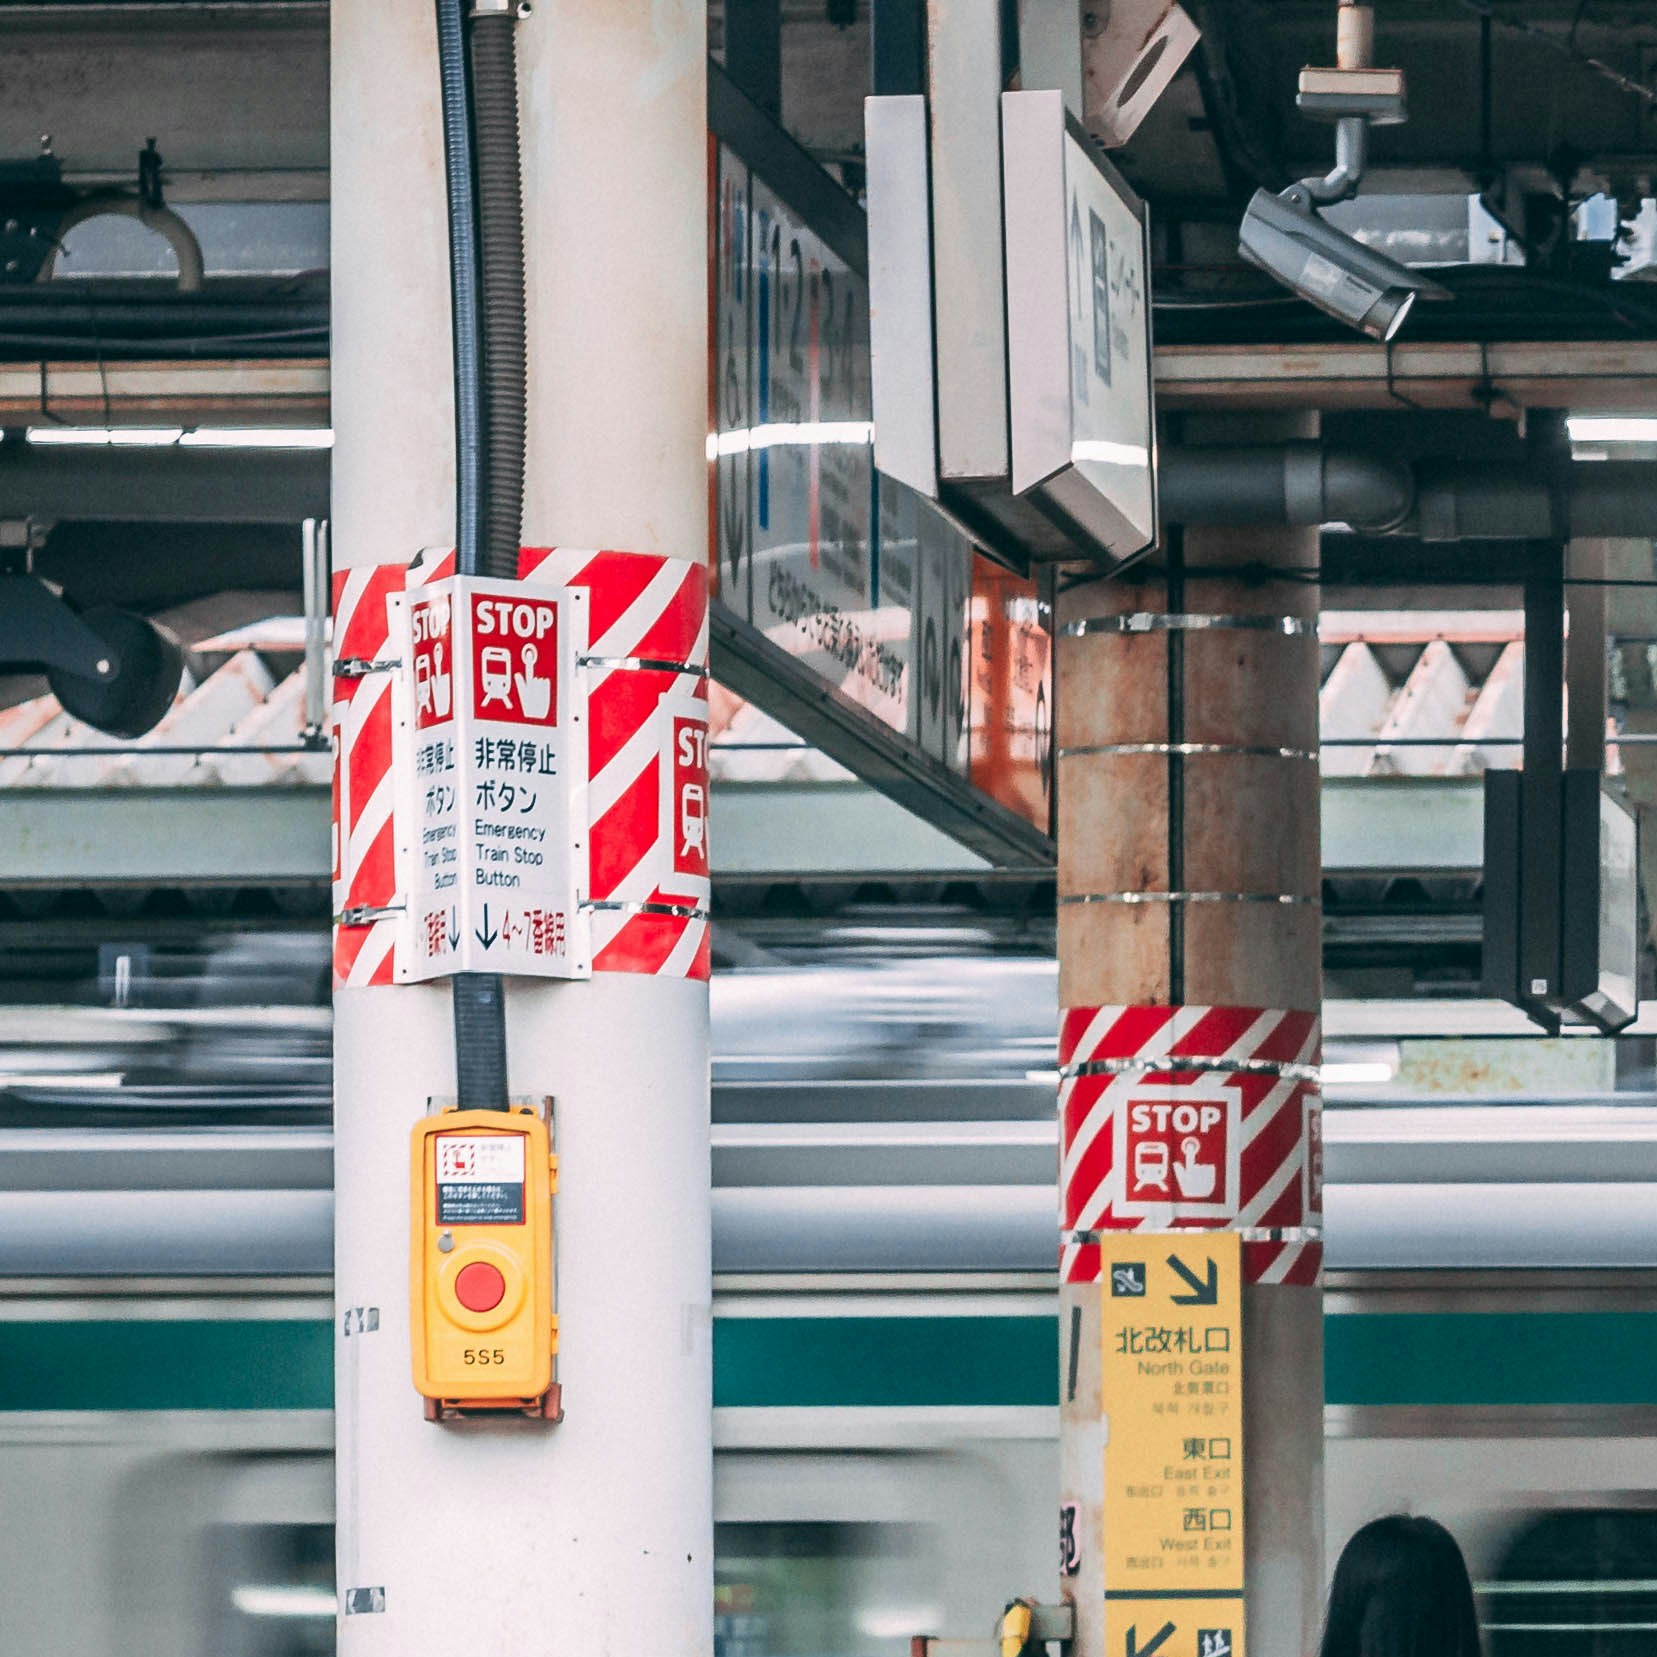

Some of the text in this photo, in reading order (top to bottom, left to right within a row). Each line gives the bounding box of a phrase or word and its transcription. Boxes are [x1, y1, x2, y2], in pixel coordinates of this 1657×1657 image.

[413, 599, 450, 644] STOP
[476, 600, 555, 640] STOP
[474, 736, 557, 775] 非常停止
[475, 779, 537, 814] ボタン
[475, 818, 546, 842] Emergency
[475, 843, 544, 867] Train Stop
[475, 868, 521, 888] Button
[1131, 1104, 1221, 1134] STOP
[1115, 1326, 1230, 1354] 北改札口
[1137, 1360, 1229, 1376] North Gate
[1182, 1437, 1232, 1460] 東口
[1163, 1465, 1231, 1480] East Exit
[1182, 1507, 1232, 1531] 西口
[1160, 1538, 1199, 1552] West
